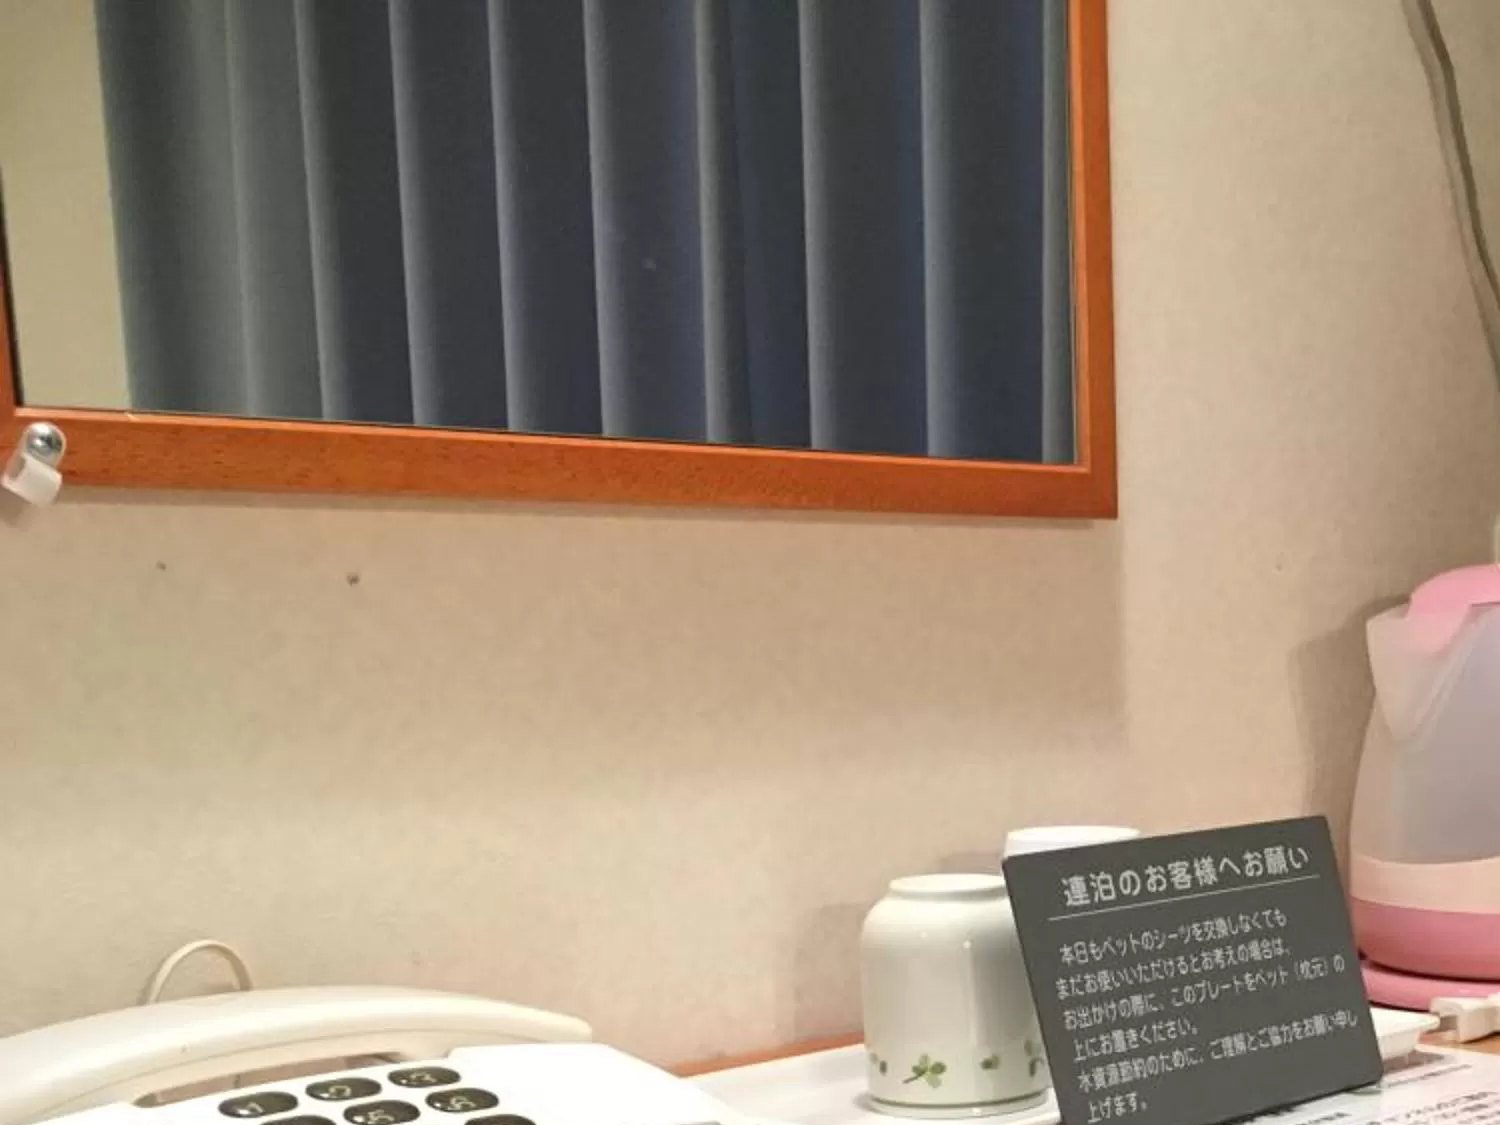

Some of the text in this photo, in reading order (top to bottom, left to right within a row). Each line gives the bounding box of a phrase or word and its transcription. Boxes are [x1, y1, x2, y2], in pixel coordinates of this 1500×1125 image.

[1060, 845, 1310, 906] 連泊のお客様へお願い
[1086, 1090, 1150, 1124] 上げます。
